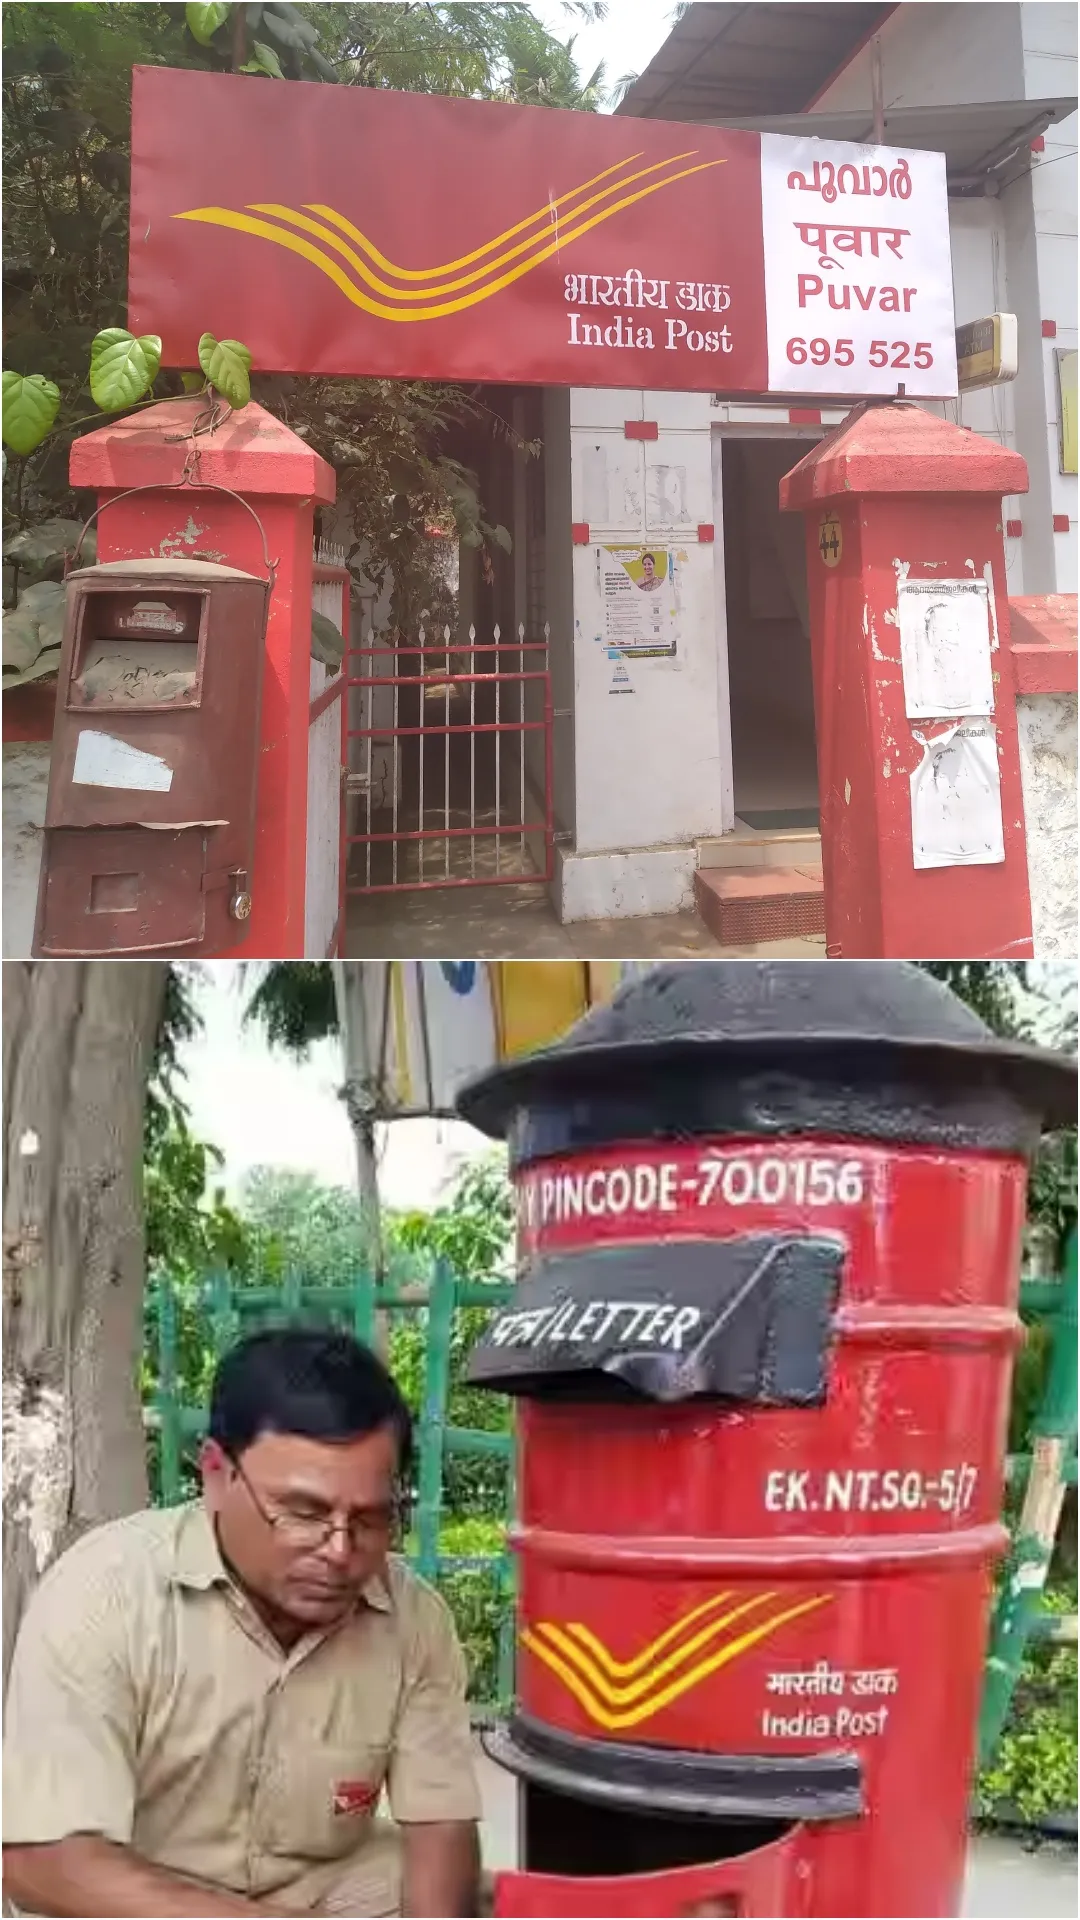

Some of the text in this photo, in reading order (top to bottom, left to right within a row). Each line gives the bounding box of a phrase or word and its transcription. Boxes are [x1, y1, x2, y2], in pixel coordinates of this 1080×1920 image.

[787, 158, 912, 203] പൂവാർ
[792, 222, 911, 270] पूवार
[564, 269, 731, 312] भारतीय डाक
[797, 274, 917, 312] Puvar
[567, 313, 733, 353] India Post
[786, 337, 934, 369] 695 525
[540, 1158, 864, 1222] PINCODE-700156
[850, 1667, 899, 1695] डाक
[762, 1703, 889, 1737] India Post
